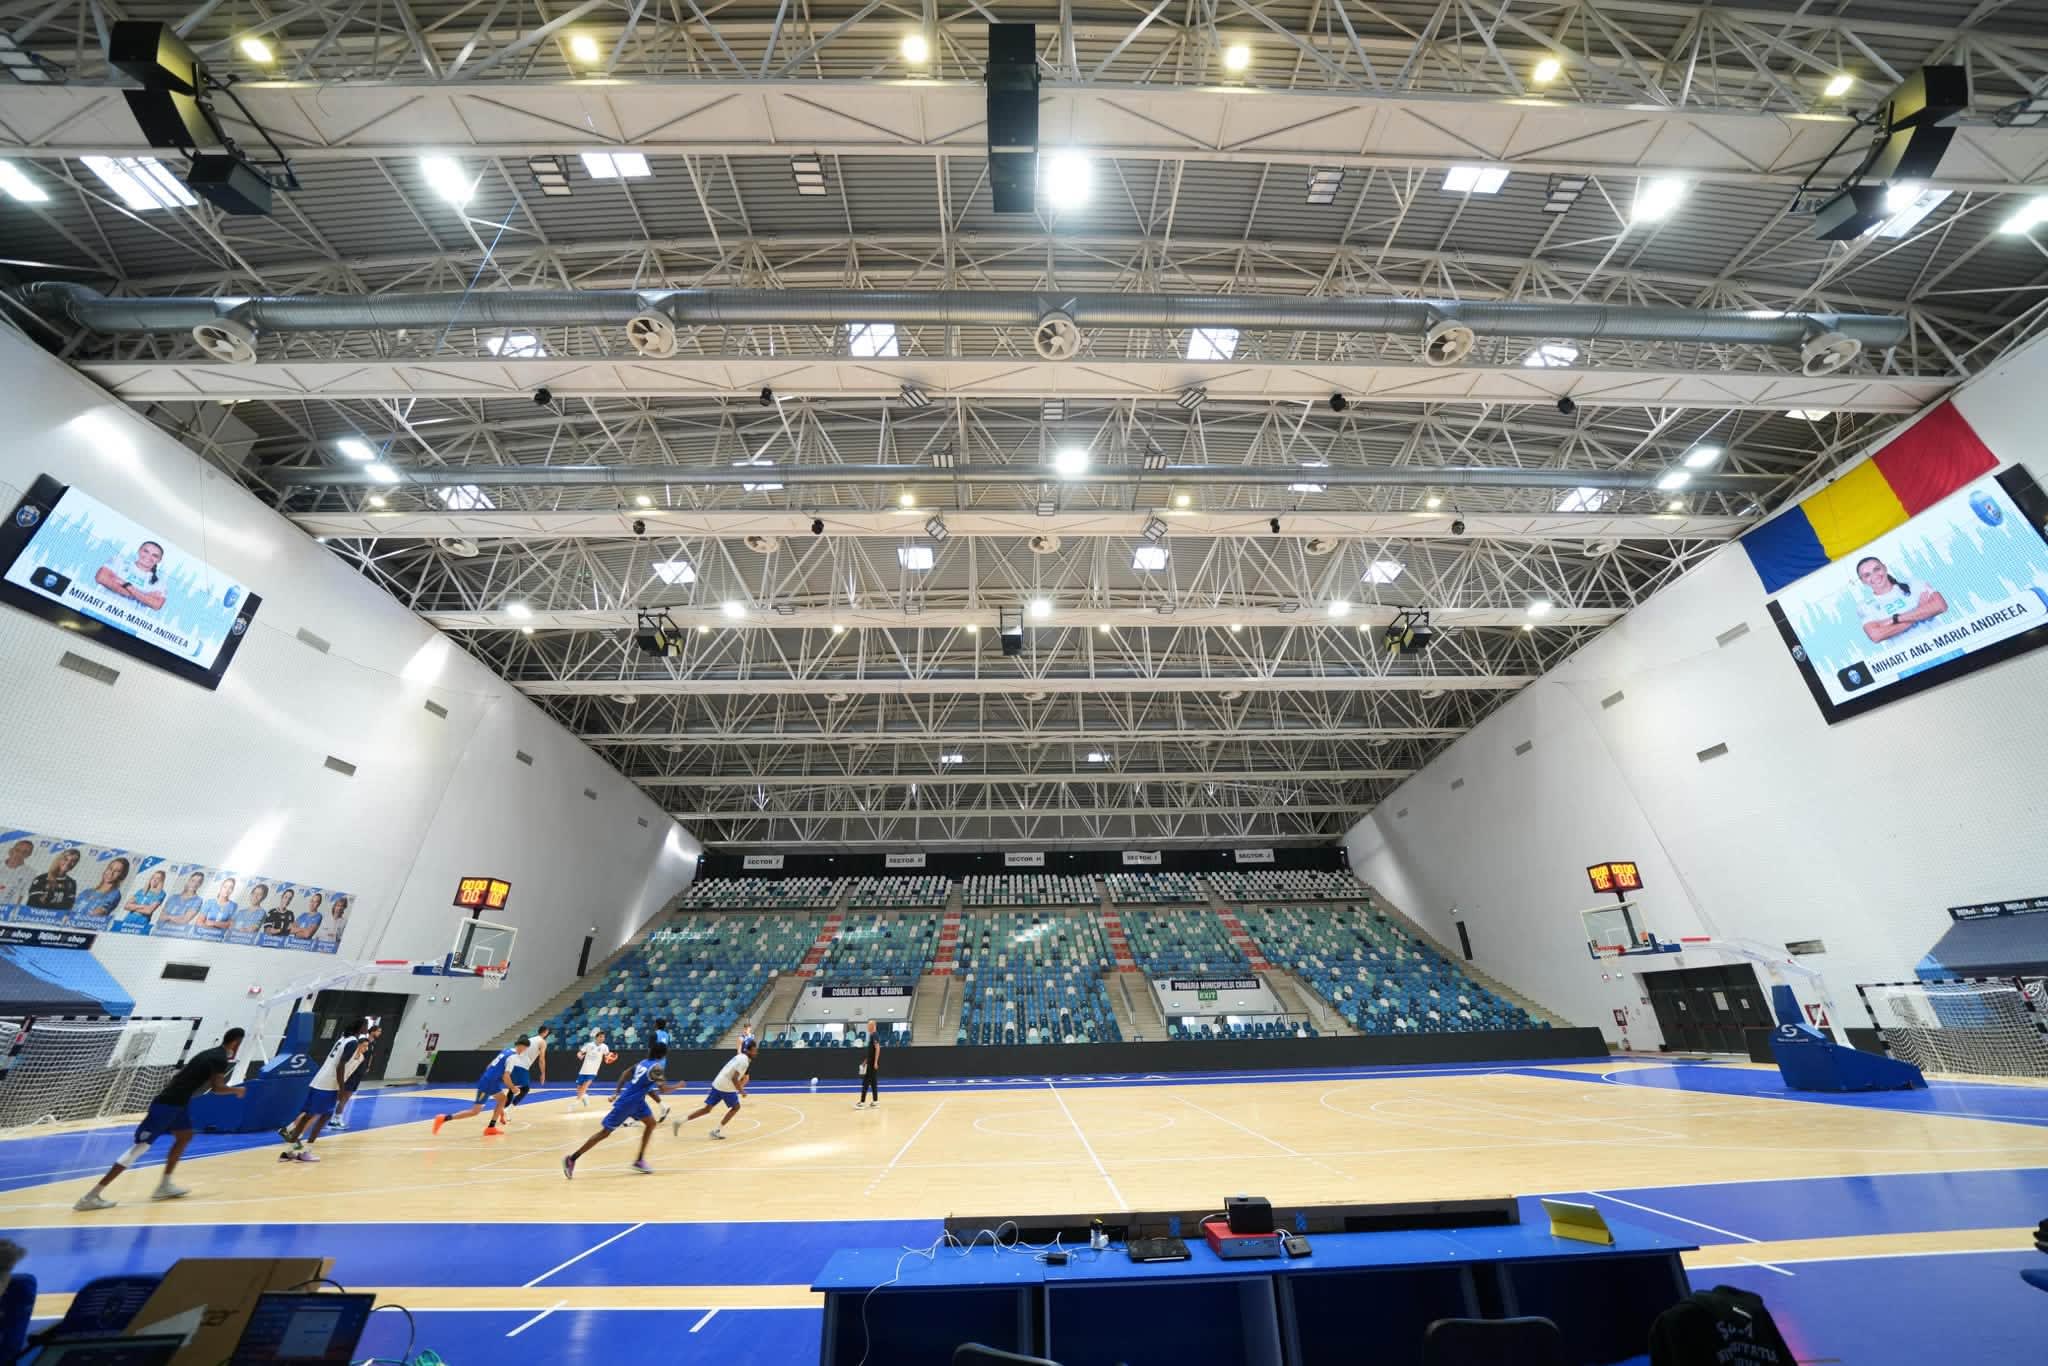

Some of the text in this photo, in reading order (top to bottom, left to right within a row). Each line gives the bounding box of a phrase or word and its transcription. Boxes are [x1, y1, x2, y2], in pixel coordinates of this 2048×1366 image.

[69, 586, 189, 648] MIHART ANA-MARIA ANDREEA
[1871, 602, 2028, 674] MIHART ANA-MARIA ANDREEA
[862, 987, 878, 996] LOCAL
[1200, 991, 1216, 999] EXIT
